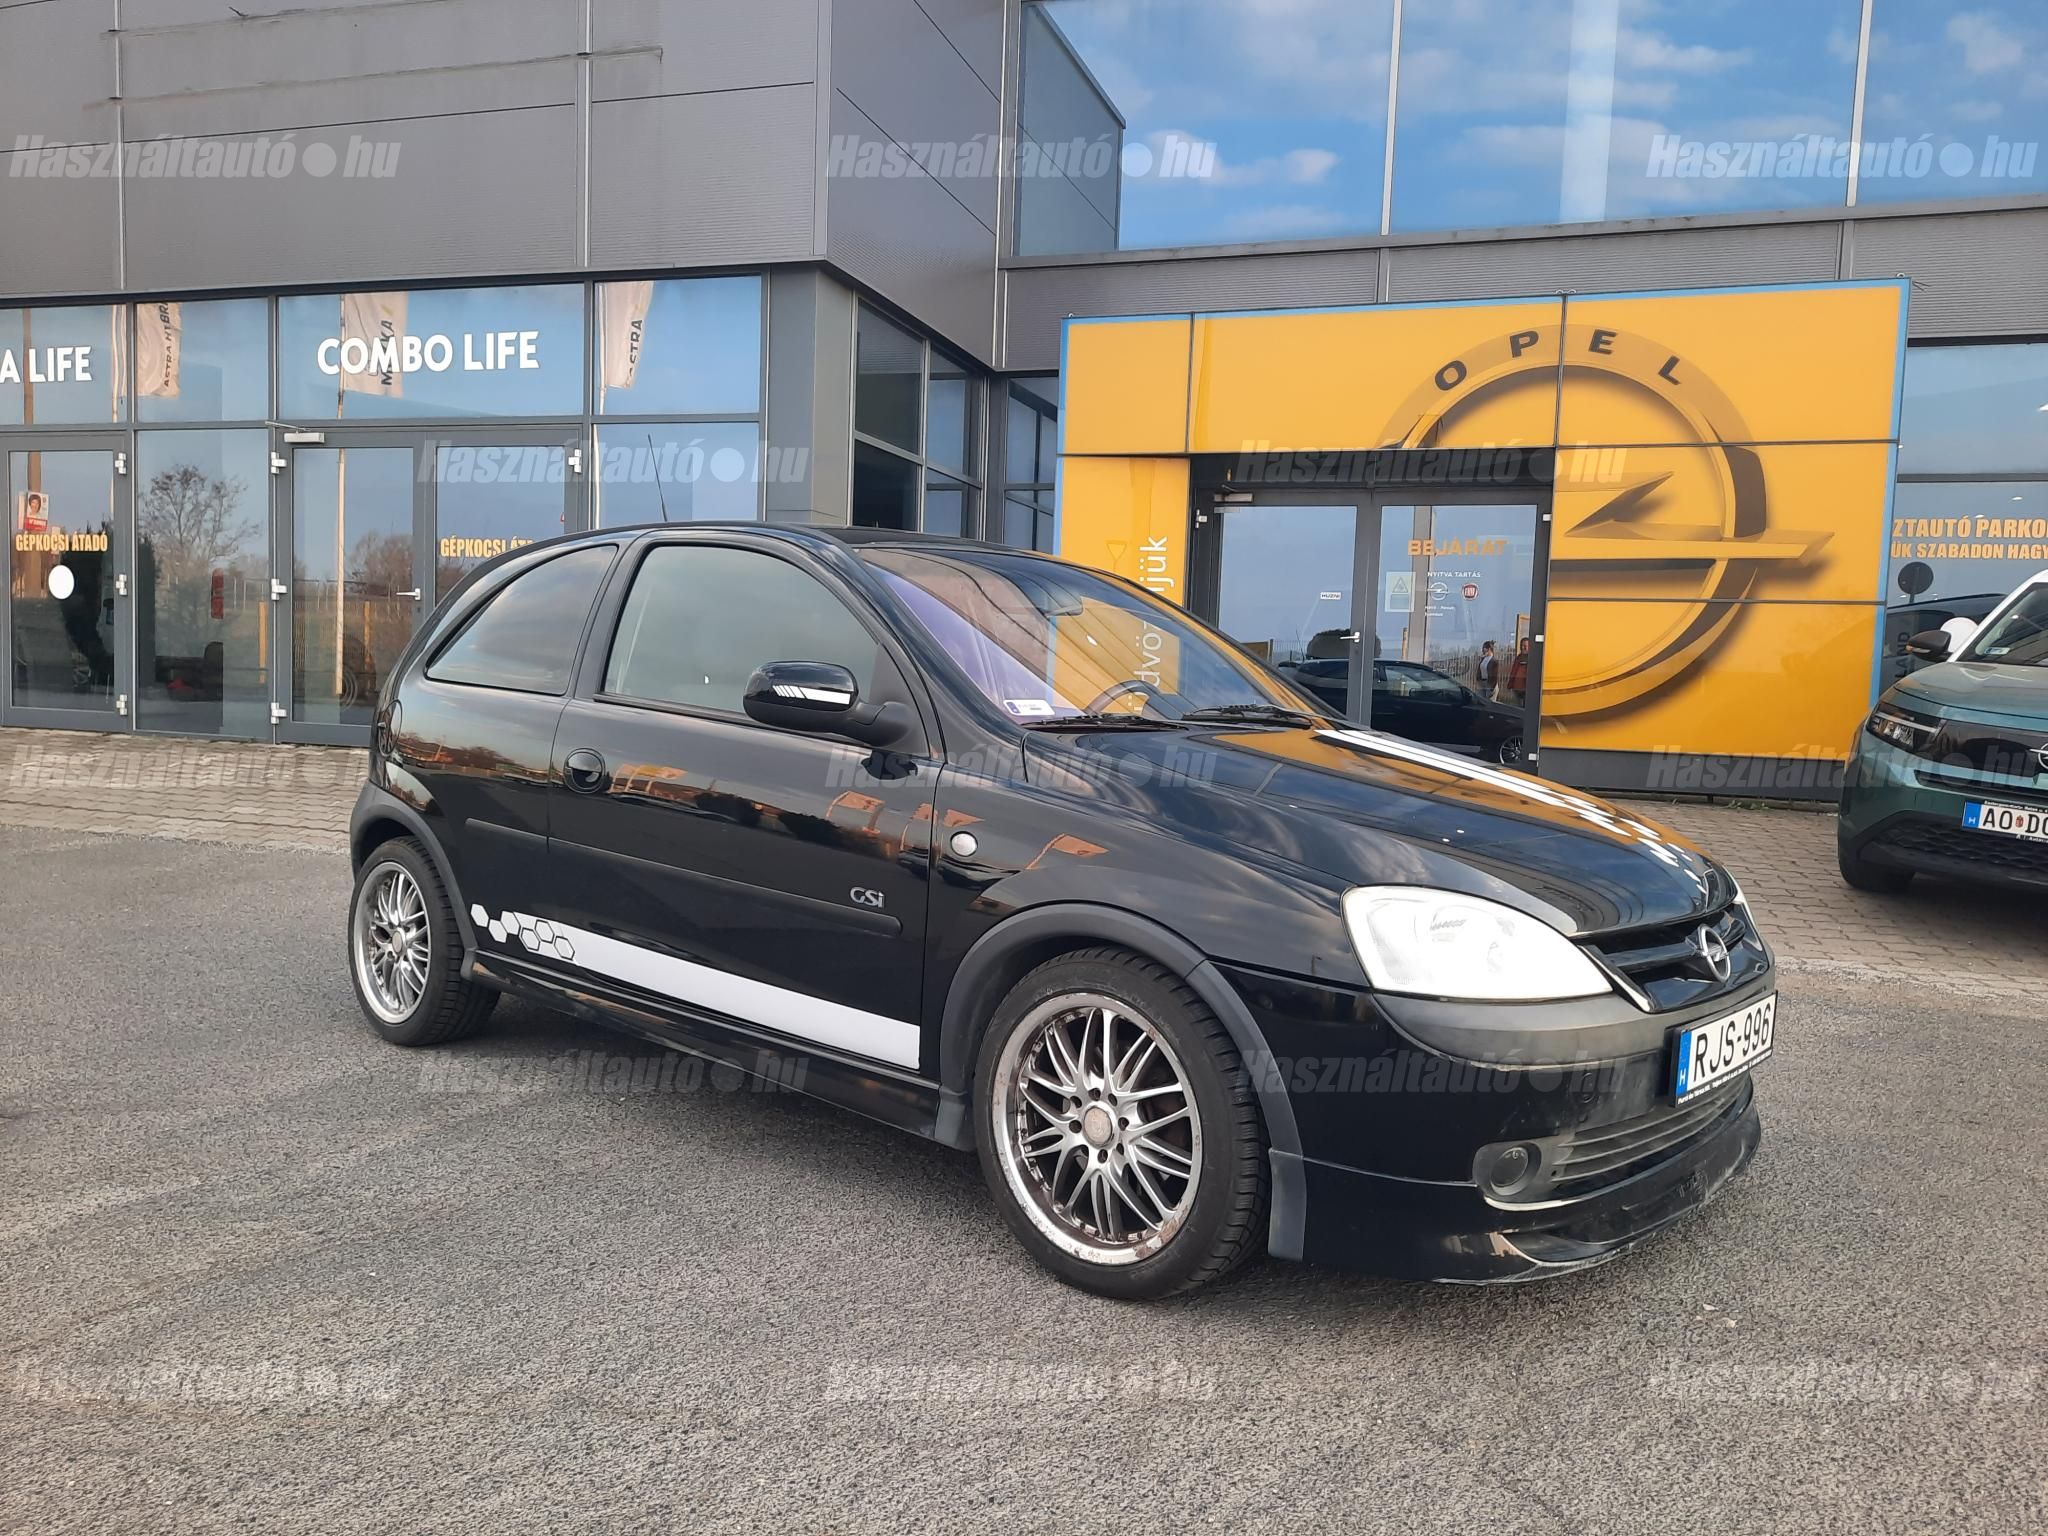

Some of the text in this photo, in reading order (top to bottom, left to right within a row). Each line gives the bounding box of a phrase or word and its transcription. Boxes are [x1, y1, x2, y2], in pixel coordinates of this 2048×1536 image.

[28, 345, 93, 383] LIFE
[317, 330, 540, 375] COMBO LIFE
[1434, 328, 1682, 391] OPEL
[1975, 518, 2048, 538] PARKO
[15, 531, 108, 552] GÉPKOCSI ÁTADÓ
[440, 535, 507, 558] GÉPKOCSI
[1916, 543, 2003, 559] SZABADON
[1982, 808, 2013, 830] AO
[1693, 1002, 1771, 1082] RJS-996
